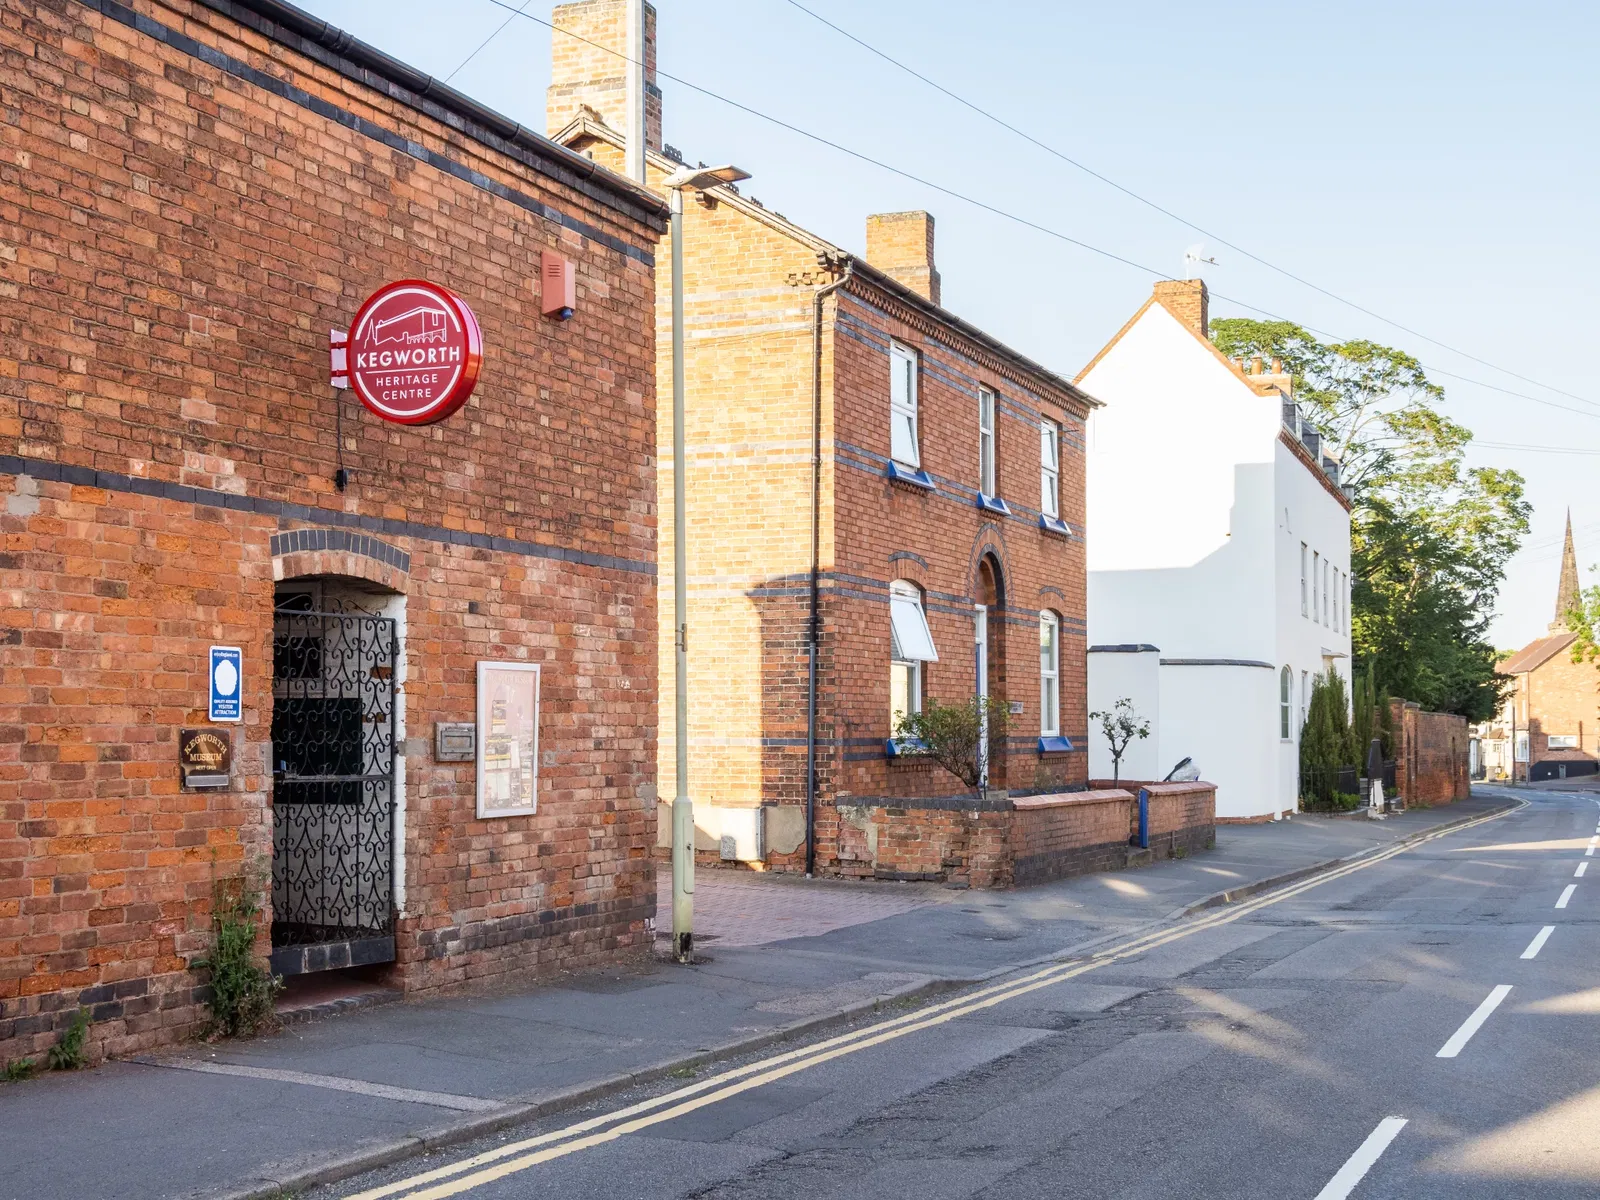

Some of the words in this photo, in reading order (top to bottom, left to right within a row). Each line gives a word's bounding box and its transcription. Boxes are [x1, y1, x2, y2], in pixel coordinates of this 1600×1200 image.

[357, 346, 460, 368] KEGWORTH
[376, 374, 438, 387] HERITAGE
[382, 388, 432, 401] CENTRE
[184, 733, 228, 755] KEGWORTH
[189, 753, 222, 762] MUSEUM
